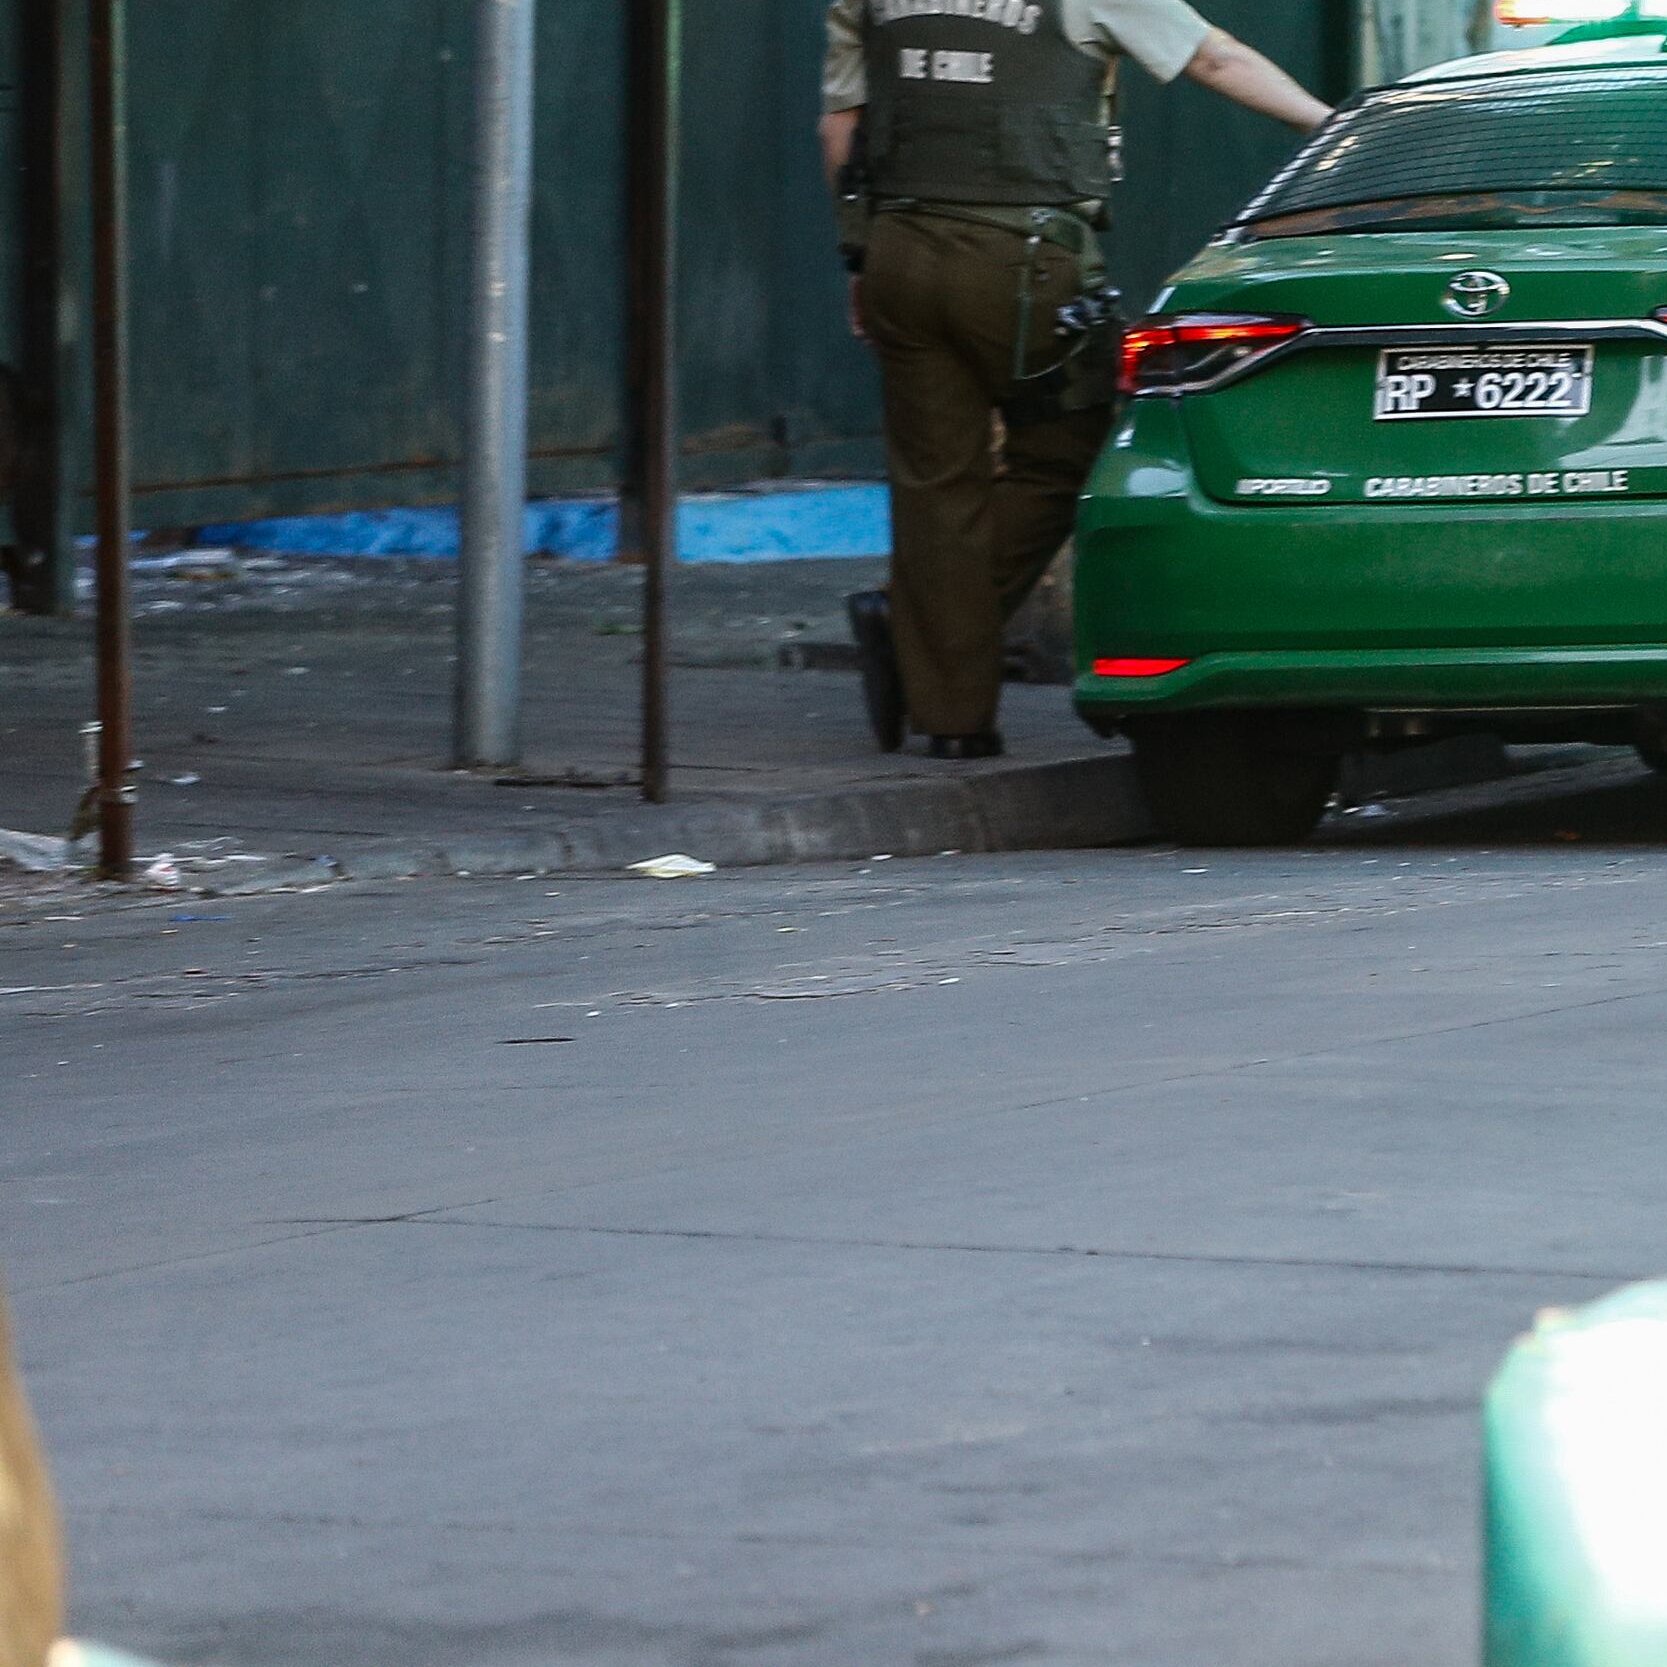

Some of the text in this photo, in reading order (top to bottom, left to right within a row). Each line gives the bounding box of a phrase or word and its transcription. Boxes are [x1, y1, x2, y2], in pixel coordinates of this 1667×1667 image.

[1383, 371, 1574, 412] RP 6222
[1364, 470, 1629, 497] CARABINEROS DE CHILE
